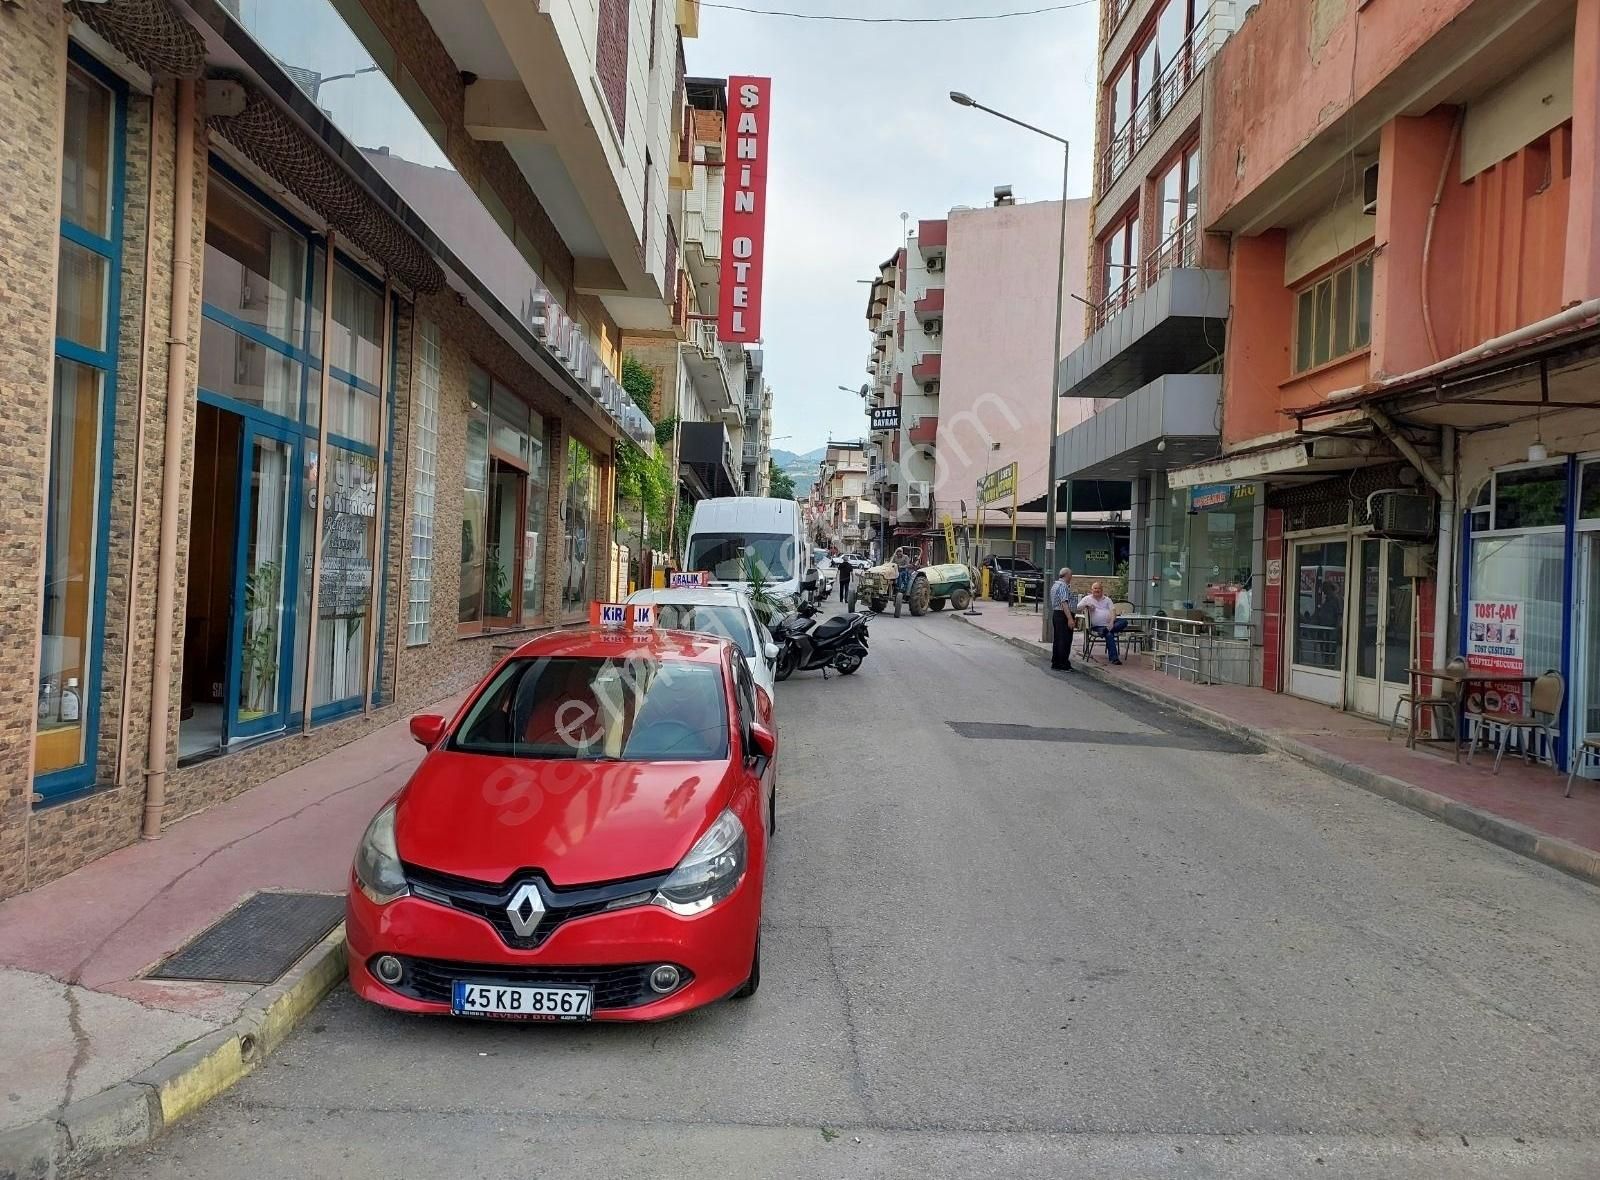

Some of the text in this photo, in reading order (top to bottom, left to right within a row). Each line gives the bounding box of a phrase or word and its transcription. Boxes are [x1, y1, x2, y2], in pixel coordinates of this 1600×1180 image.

[732, 84, 759, 333] ŞAHİN OTEL
[874, 409, 898, 418] OTEL
[873, 417, 898, 427] BAYRAK
[603, 606, 650, 623] KİRIK
[1475, 603, 1518, 623] TOST-ÇAY
[1475, 644, 1487, 653] TOST
[465, 988, 588, 1013] 45 KB 8567
[486, 1011, 528, 1019] LEVENT
[532, 1013, 556, 1021] OTO
